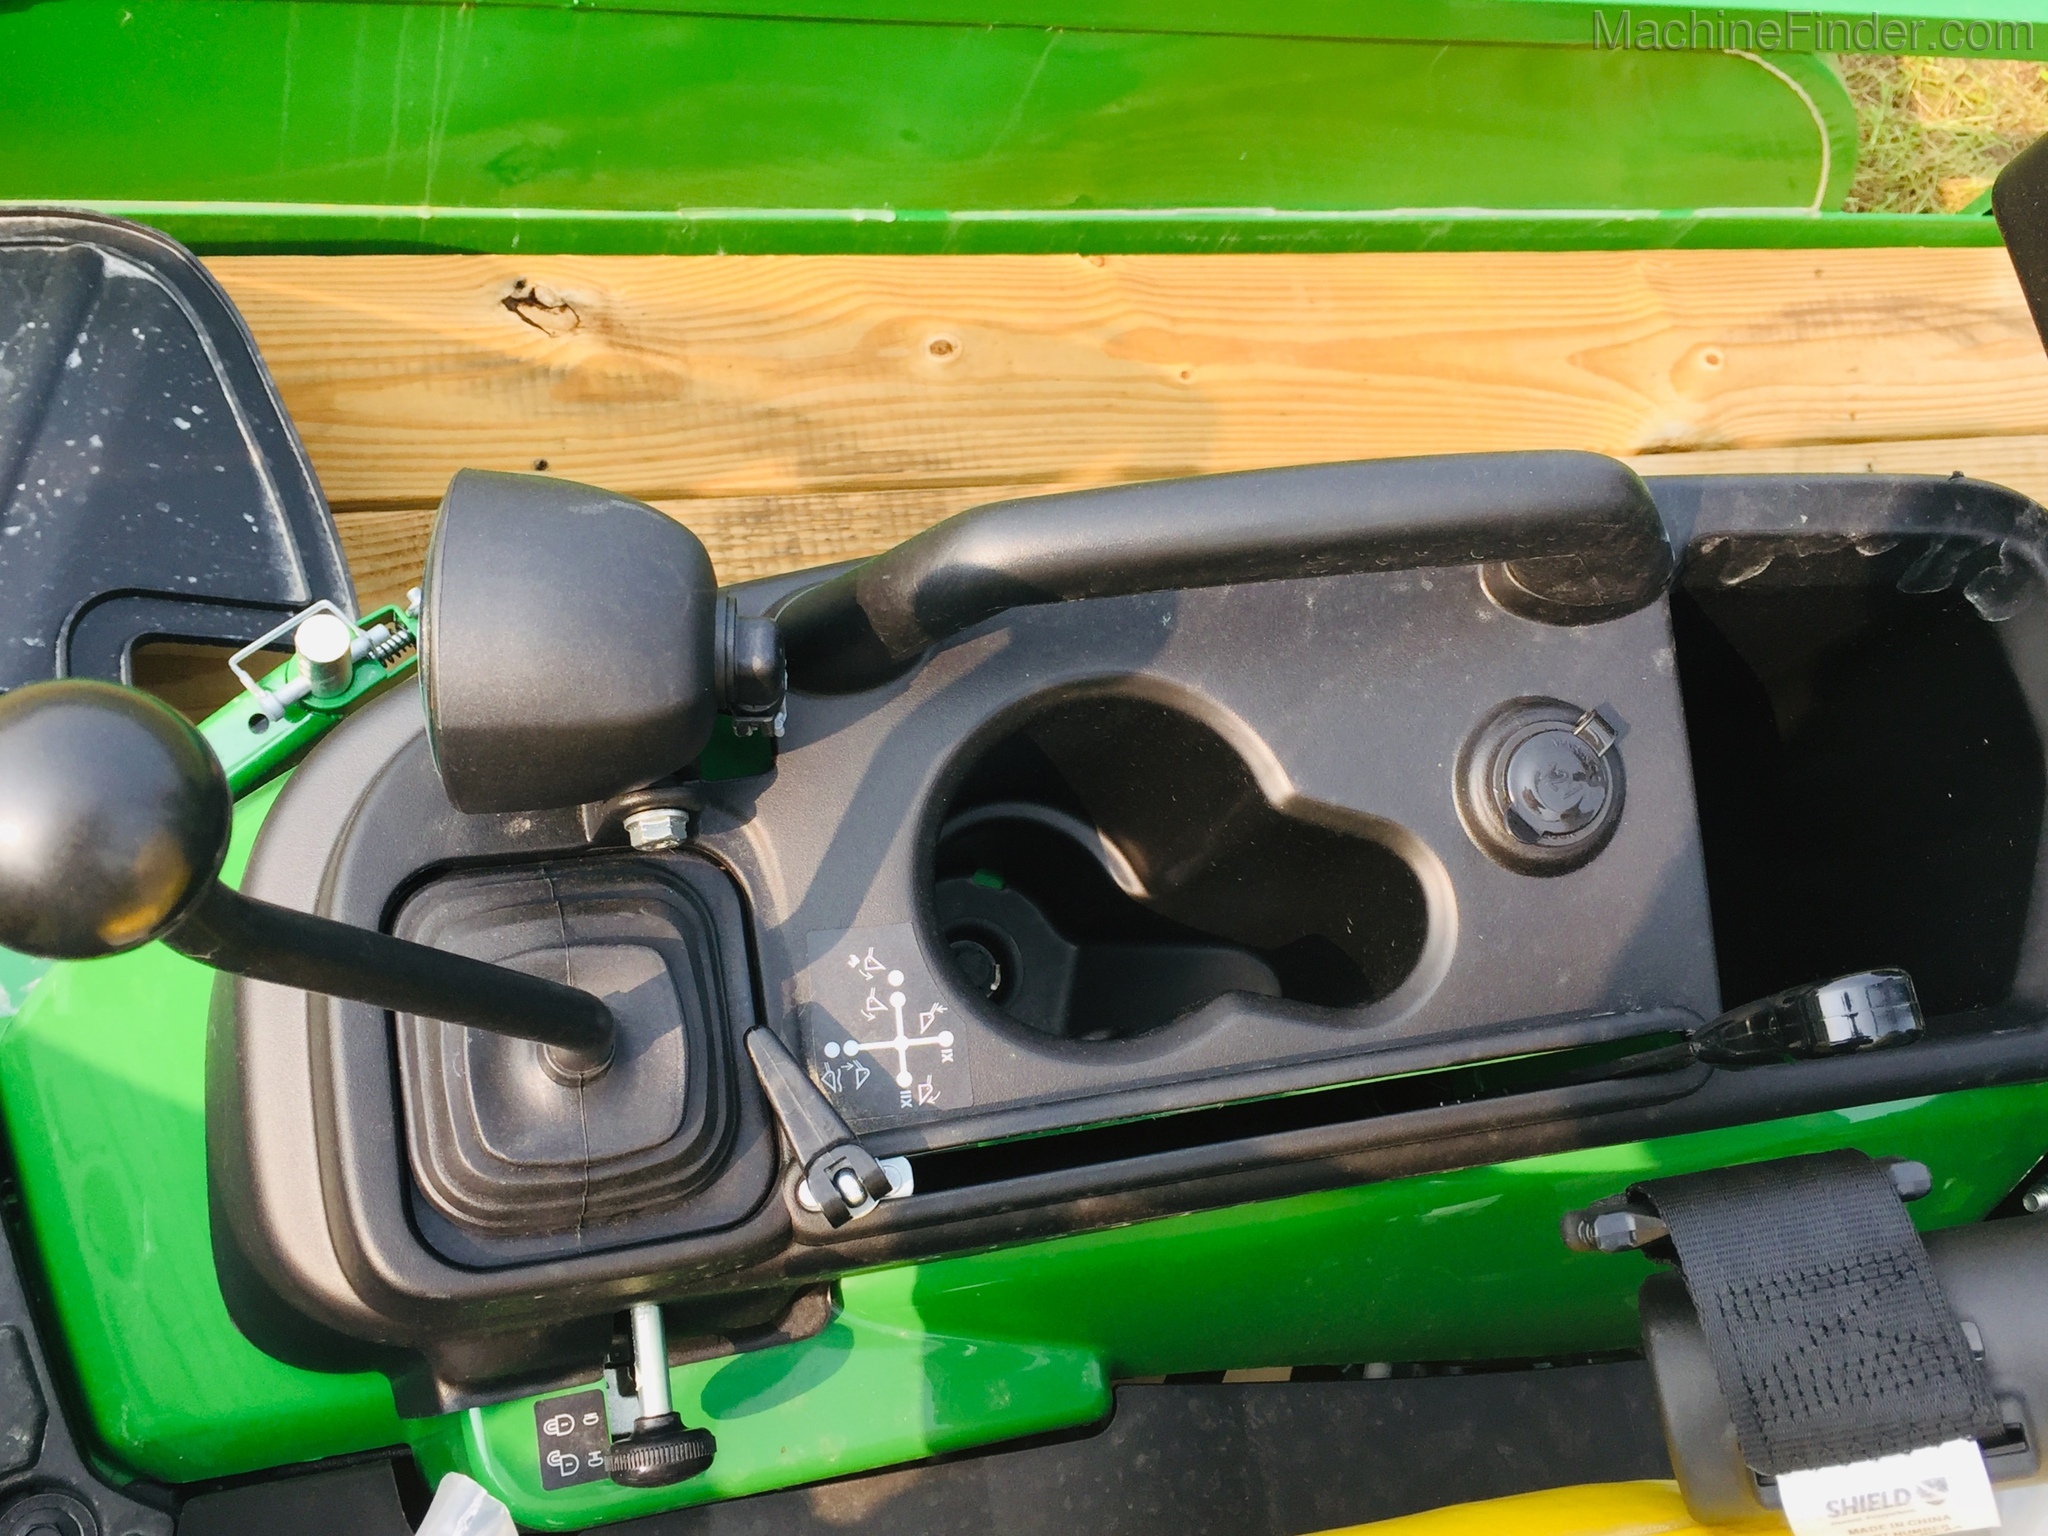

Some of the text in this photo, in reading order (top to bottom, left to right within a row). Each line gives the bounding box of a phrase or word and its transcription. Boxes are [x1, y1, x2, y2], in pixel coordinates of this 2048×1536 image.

[1826, 1488, 1912, 1518] SHIELD
[1848, 1523, 1886, 1536] MADE
[1907, 1514, 1952, 1526] CHINA
